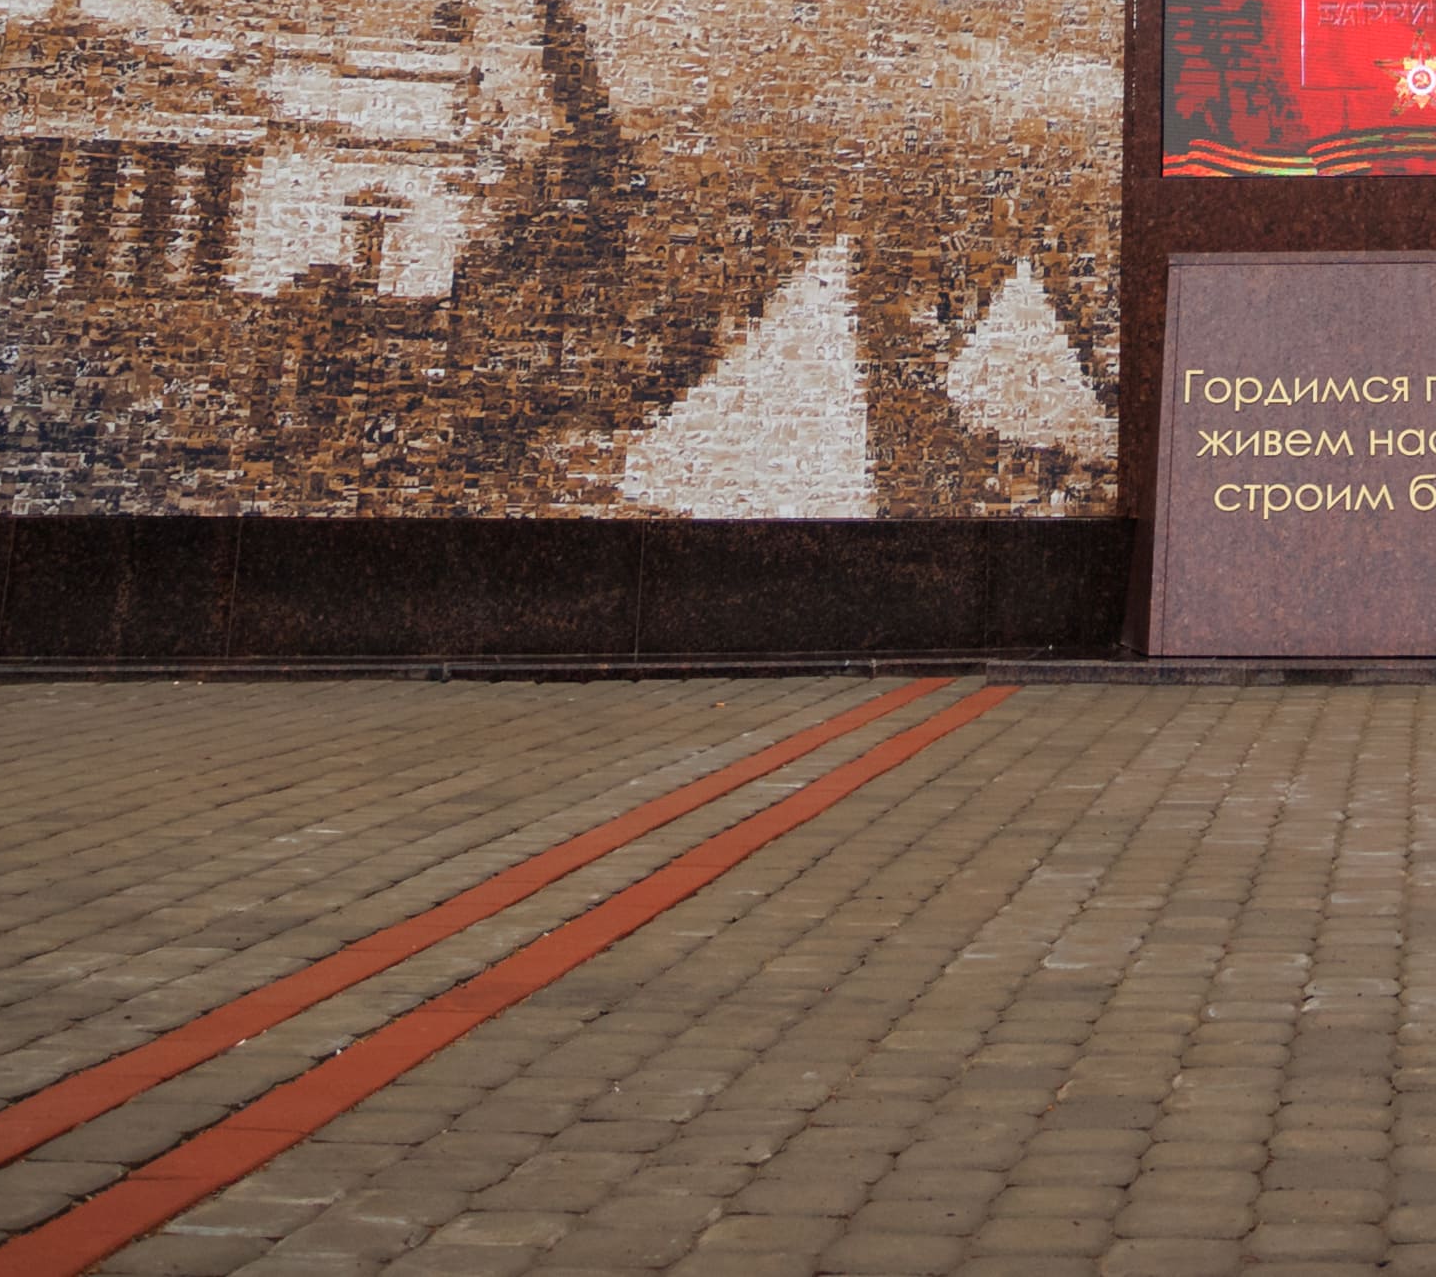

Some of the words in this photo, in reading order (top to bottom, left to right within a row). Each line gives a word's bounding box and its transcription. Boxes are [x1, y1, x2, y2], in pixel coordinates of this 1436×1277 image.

[1183, 369, 1409, 411] Гордимся
[1196, 428, 1354, 457] живем
[1213, 481, 1395, 519] строим
